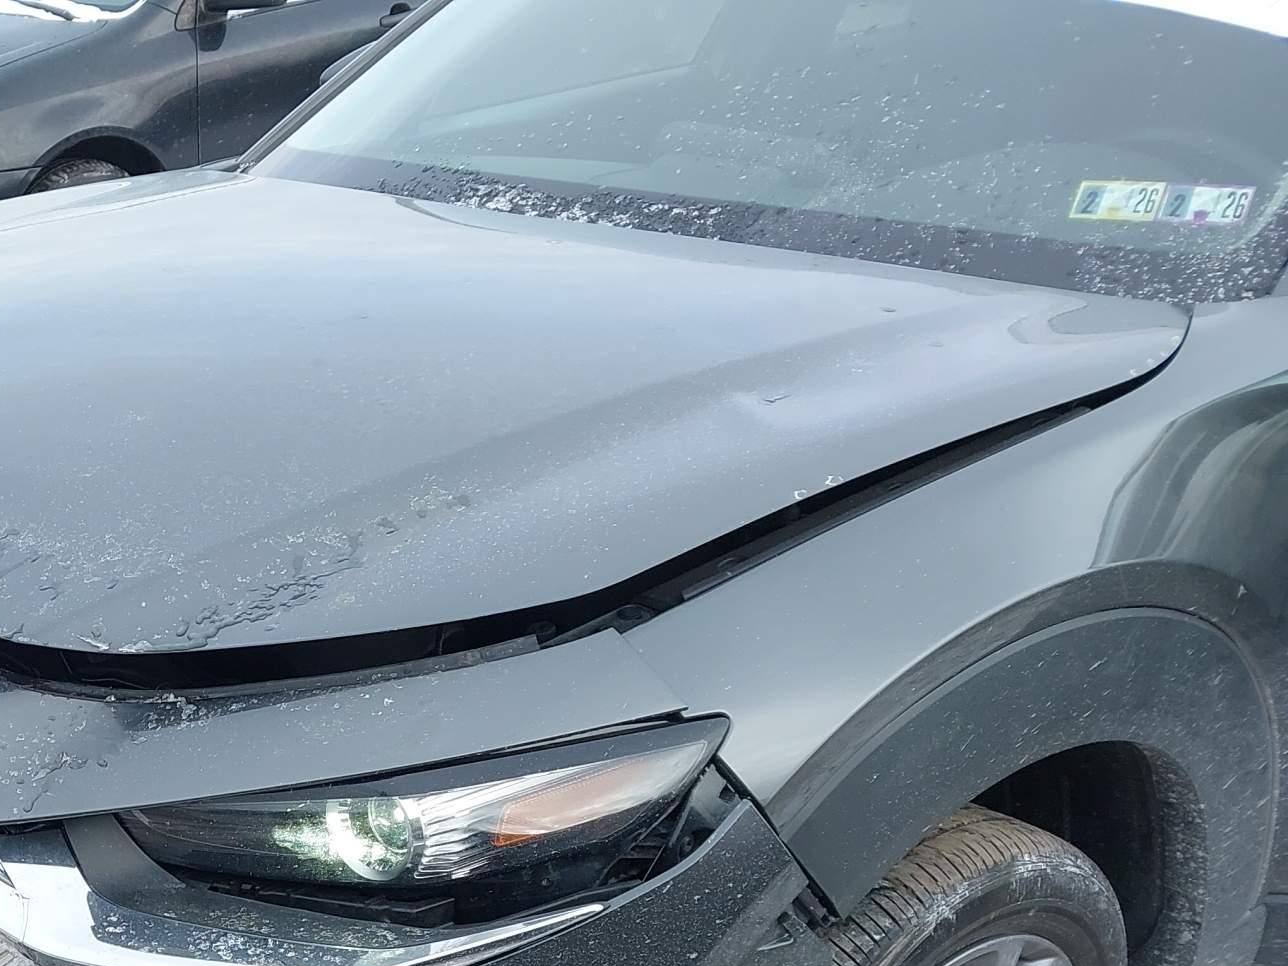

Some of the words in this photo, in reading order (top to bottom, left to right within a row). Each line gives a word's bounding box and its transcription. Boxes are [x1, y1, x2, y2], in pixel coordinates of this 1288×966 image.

[1080, 191, 1099, 214] 2
[1132, 187, 1160, 214] 26
[1169, 194, 1186, 217] 2
[1221, 192, 1249, 219] 26
